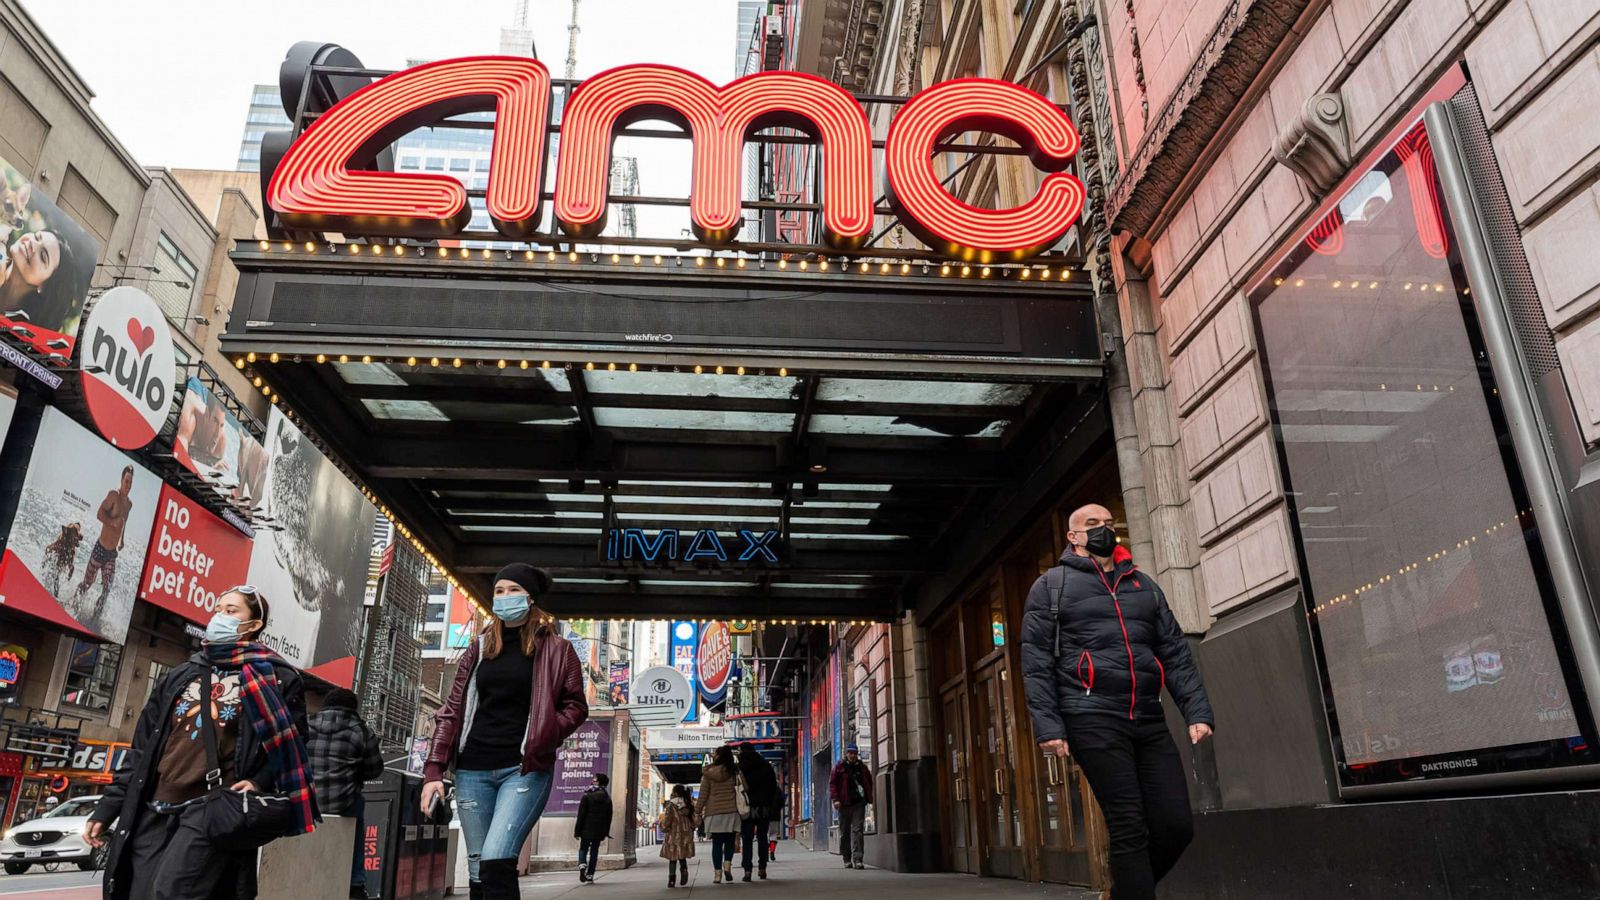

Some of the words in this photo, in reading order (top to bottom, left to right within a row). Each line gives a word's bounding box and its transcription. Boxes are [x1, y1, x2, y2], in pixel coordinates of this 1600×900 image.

[265, 55, 1085, 250] amc
[33, 366, 58, 387] PRIME
[93, 326, 164, 411] nulo
[165, 499, 190, 529] no
[157, 525, 214, 578] better
[608, 528, 778, 562] IMAX
[149, 564, 185, 598] pet
[187, 576, 220, 613] foo
[702, 631, 723, 663] DAVE
[722, 628, 730, 645] &
[637, 695, 684, 708] Hilton
[579, 730, 599, 741] only
[579, 741, 597, 749] that
[559, 749, 582, 760] gives
[583, 750, 600, 760] you
[564, 760, 593, 768] karma
[1421, 758, 1478, 771] DAKTRONICS
[562, 770, 594, 779] points.
